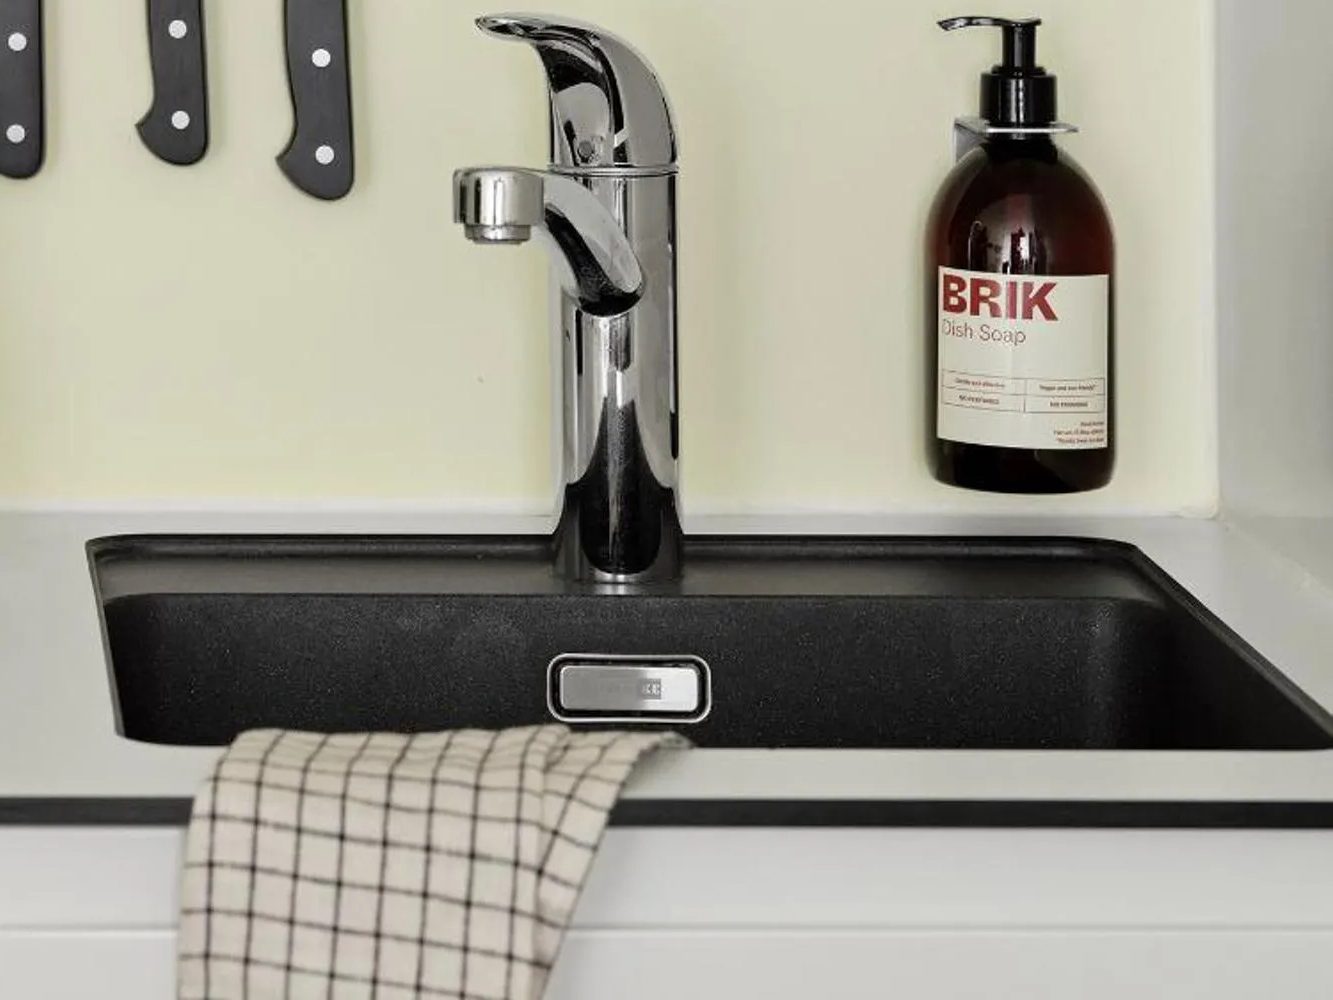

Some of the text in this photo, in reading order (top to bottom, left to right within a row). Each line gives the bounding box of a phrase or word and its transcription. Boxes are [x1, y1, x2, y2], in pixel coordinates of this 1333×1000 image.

[943, 274, 1058, 321] BRIK
[942, 318, 1026, 345] Dish Soap
